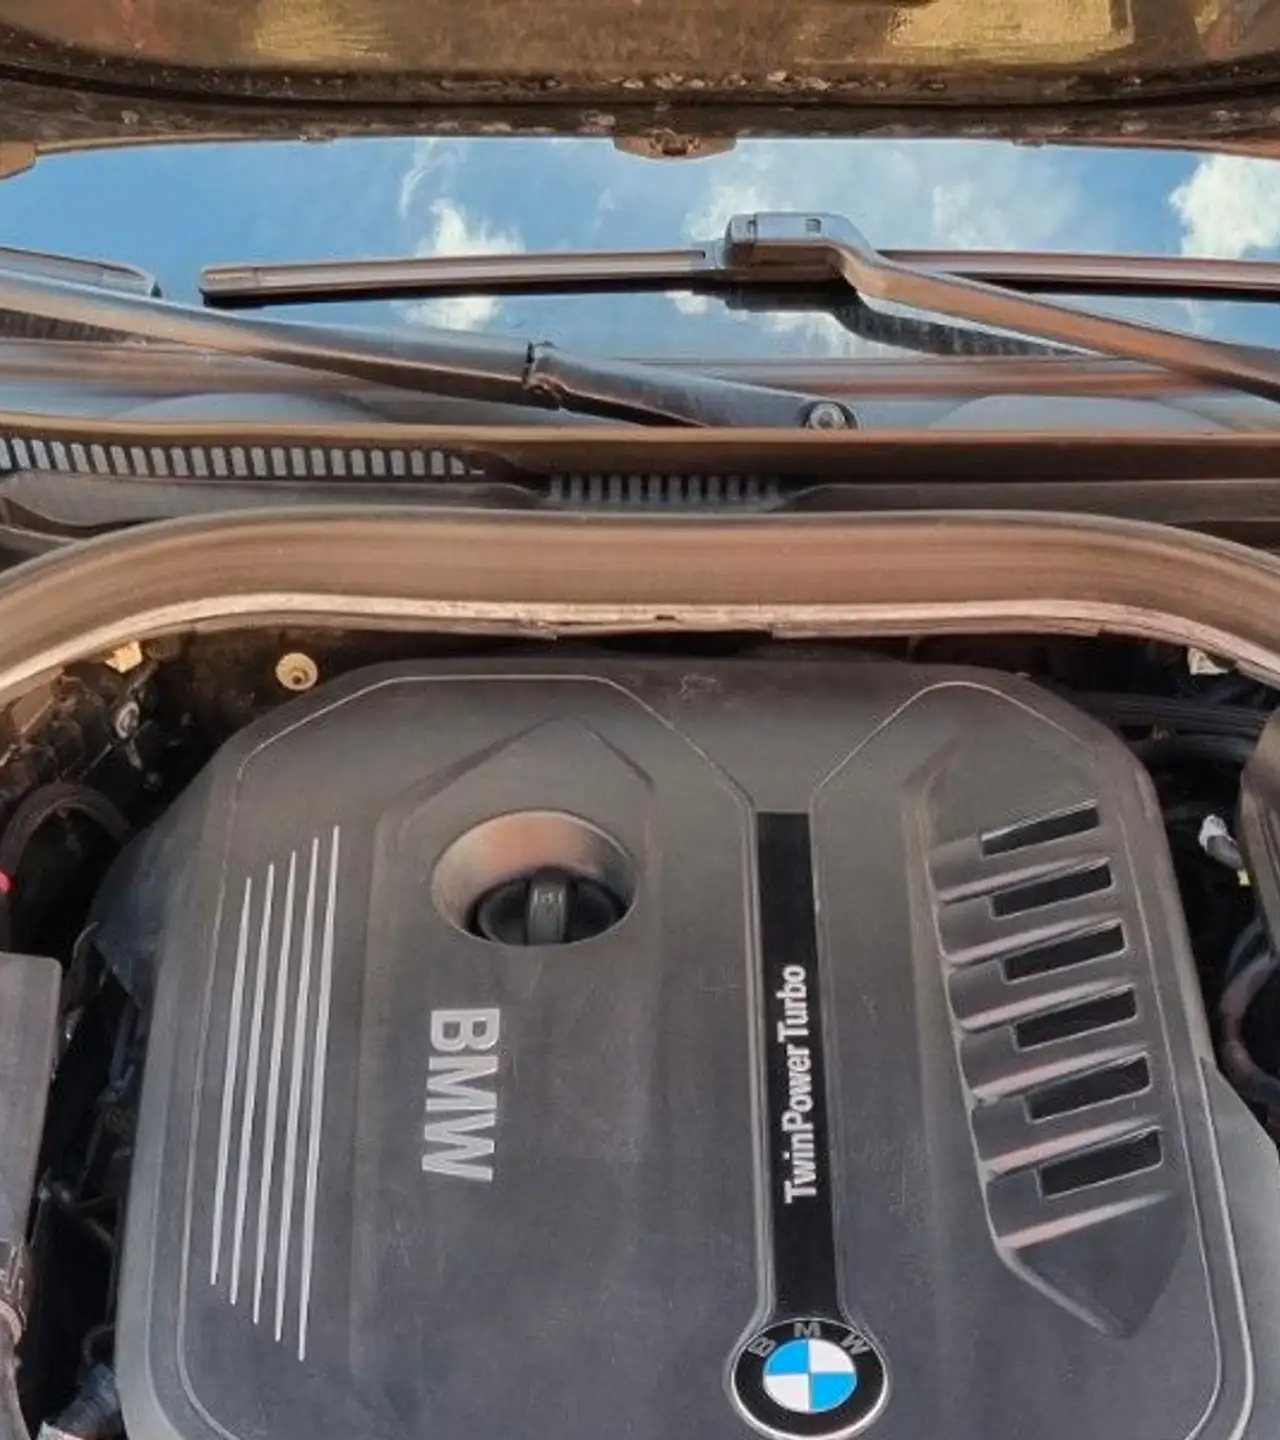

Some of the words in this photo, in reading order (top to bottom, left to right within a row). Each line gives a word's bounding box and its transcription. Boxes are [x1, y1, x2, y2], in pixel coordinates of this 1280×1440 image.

[776, 965, 810, 1043] Turbo
[421, 1008, 501, 1182] BMW
[781, 1043, 817, 1204] TwinPower
[748, 1321, 870, 1358] BMW
